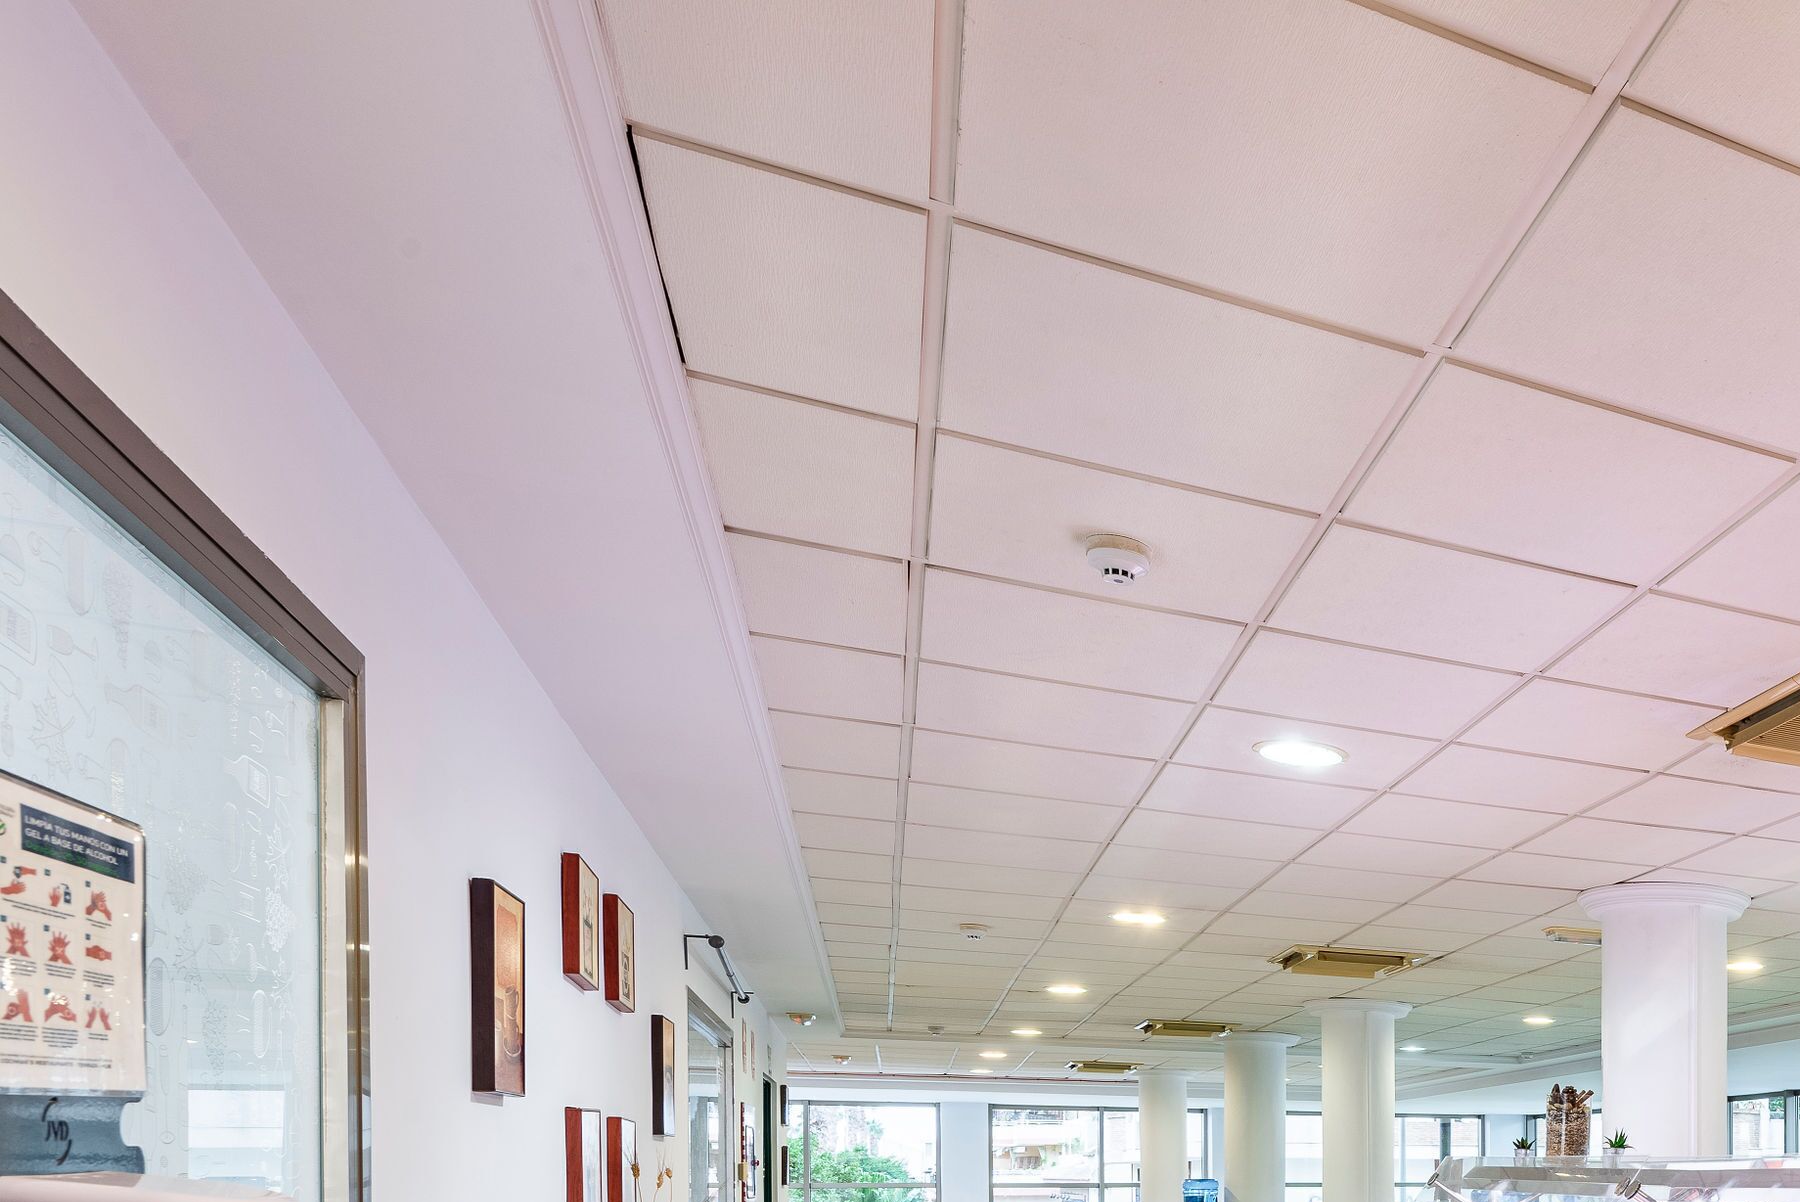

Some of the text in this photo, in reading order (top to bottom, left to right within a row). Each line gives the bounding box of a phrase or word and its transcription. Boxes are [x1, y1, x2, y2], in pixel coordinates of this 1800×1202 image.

[24, 828, 119, 866] GEL A BASE DE ALCOHOL
[55, 824, 71, 838] TUS
[71, 831, 100, 847] MANOS
[100, 842, 115, 853] CON
[116, 847, 129, 857] UN
[45, 1120, 69, 1142] JVD
